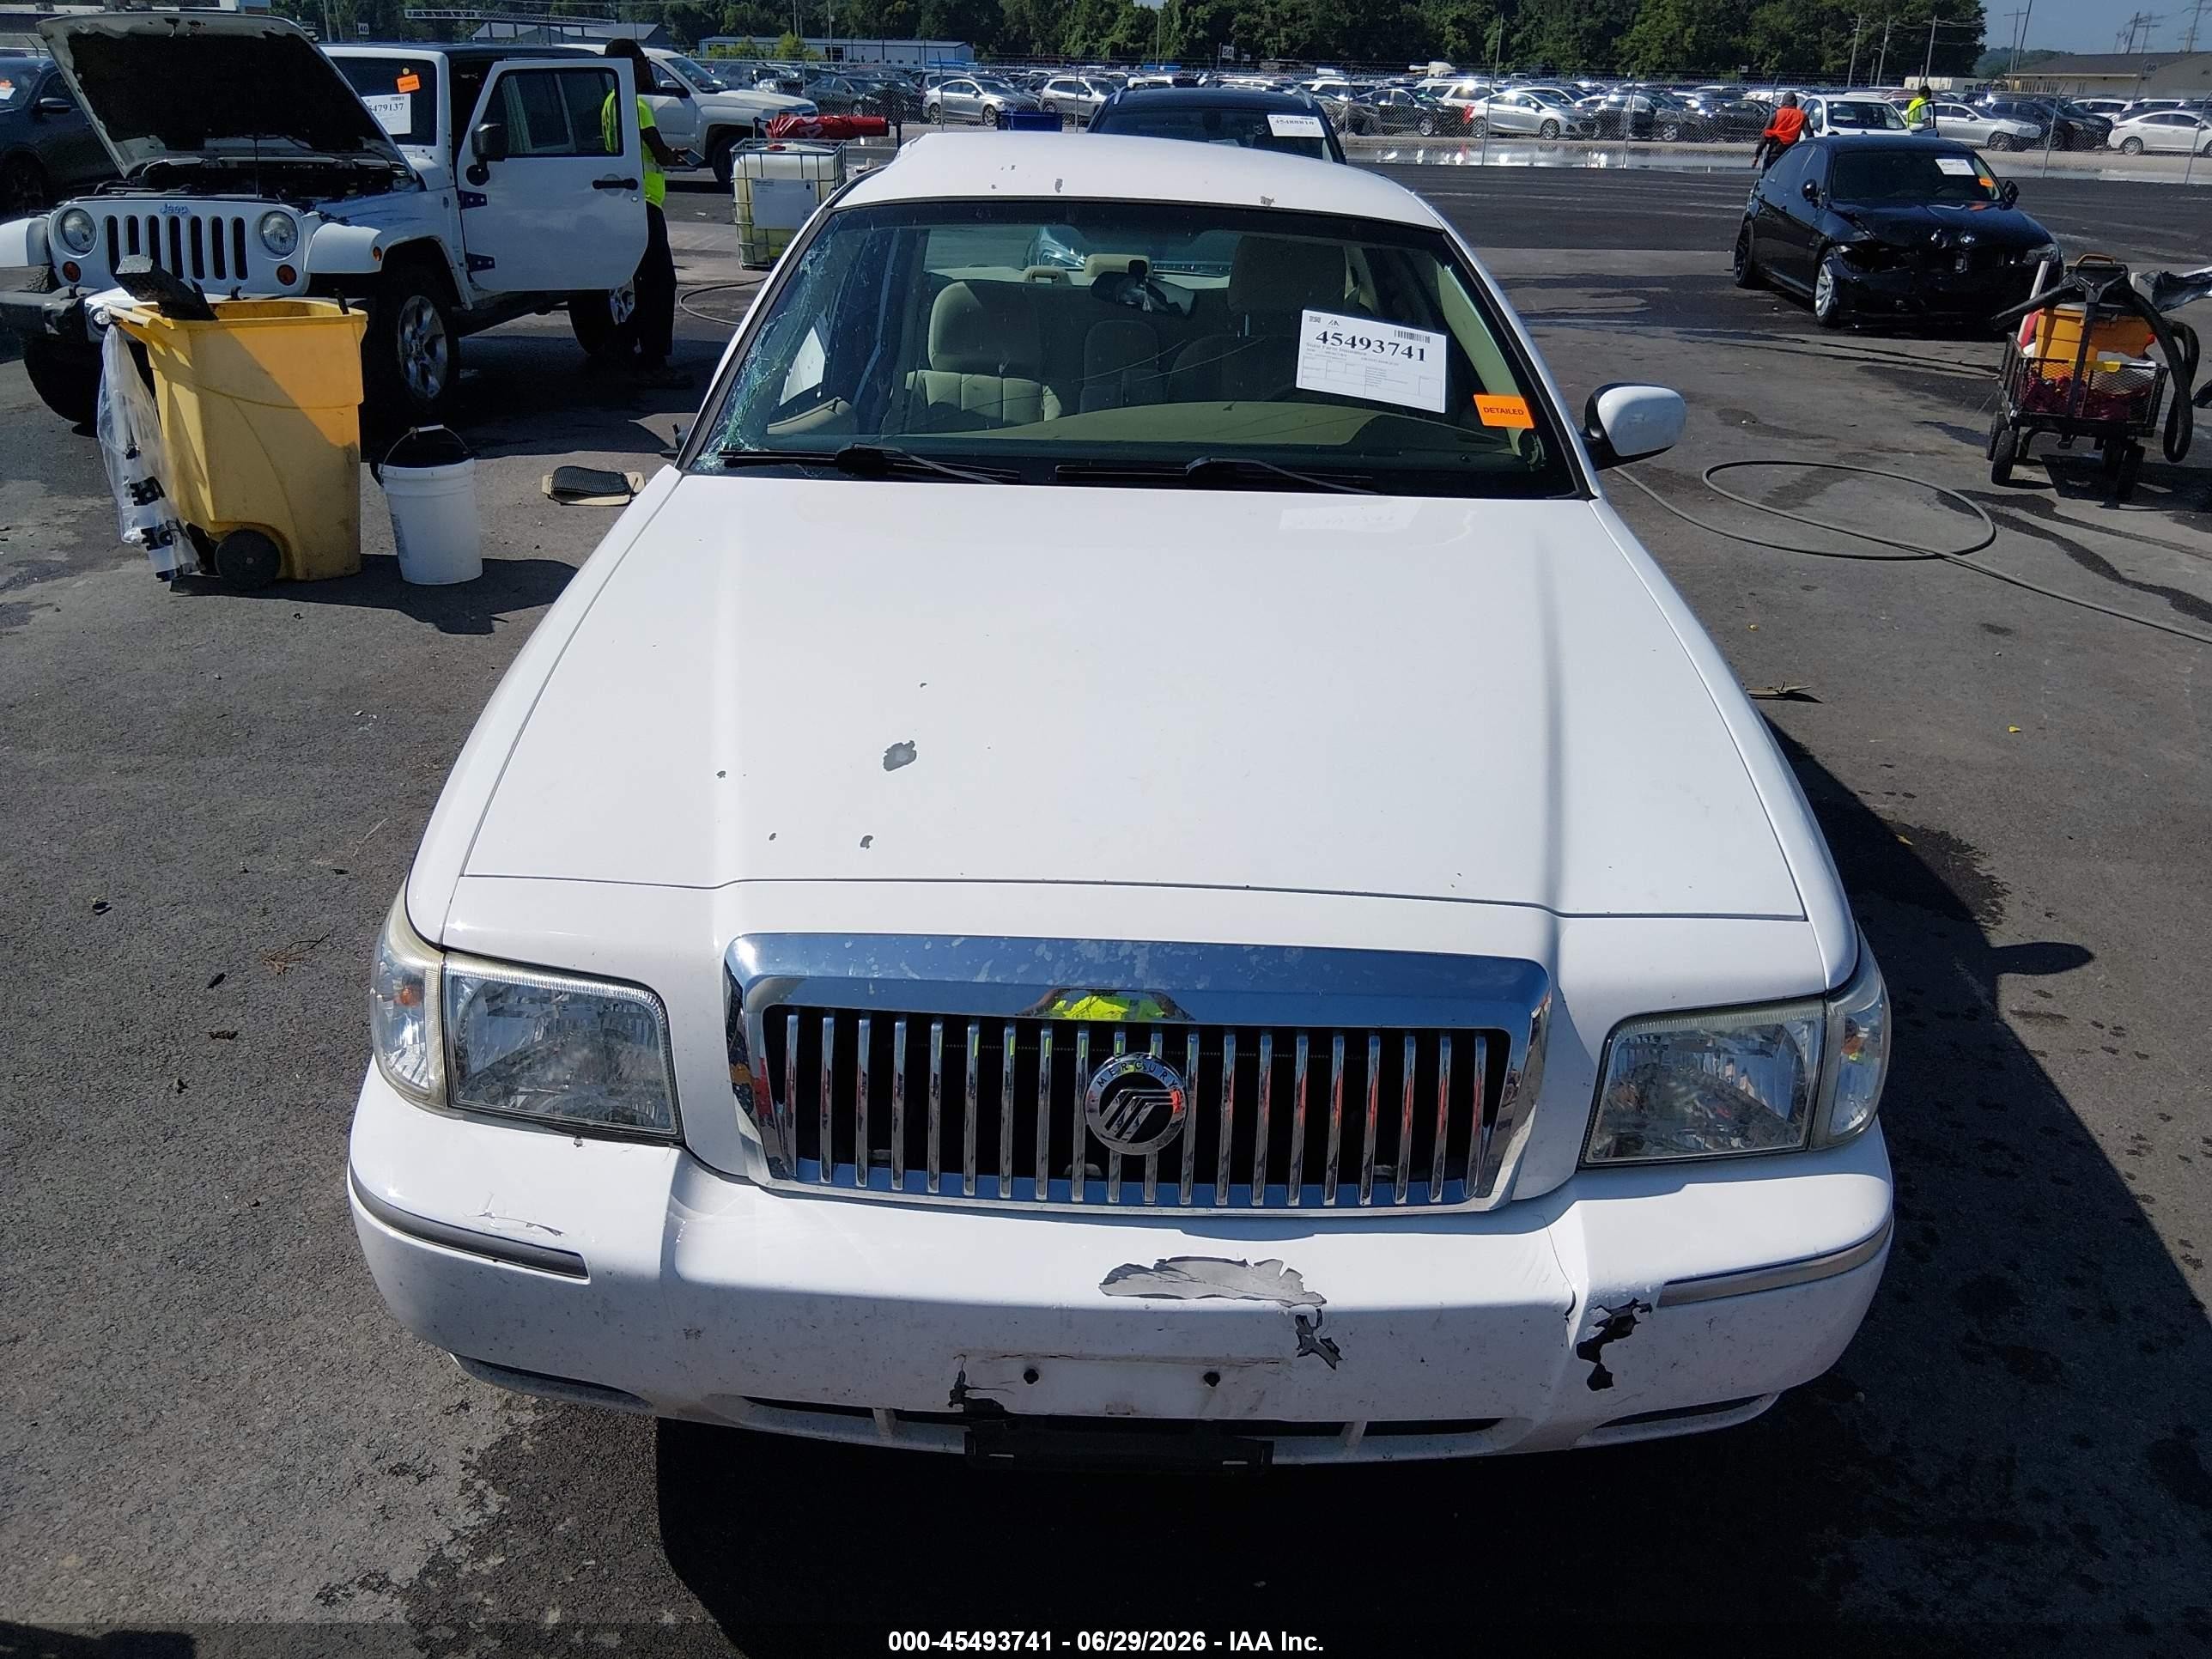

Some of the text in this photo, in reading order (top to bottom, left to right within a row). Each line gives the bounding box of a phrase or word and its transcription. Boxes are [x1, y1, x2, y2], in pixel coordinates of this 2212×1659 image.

[160, 203, 189, 215] Jeep
[1316, 331, 1426, 362] 45493741
[1483, 407, 1524, 416] DETAILED
[1097, 1061, 1179, 1088] MERCURY
